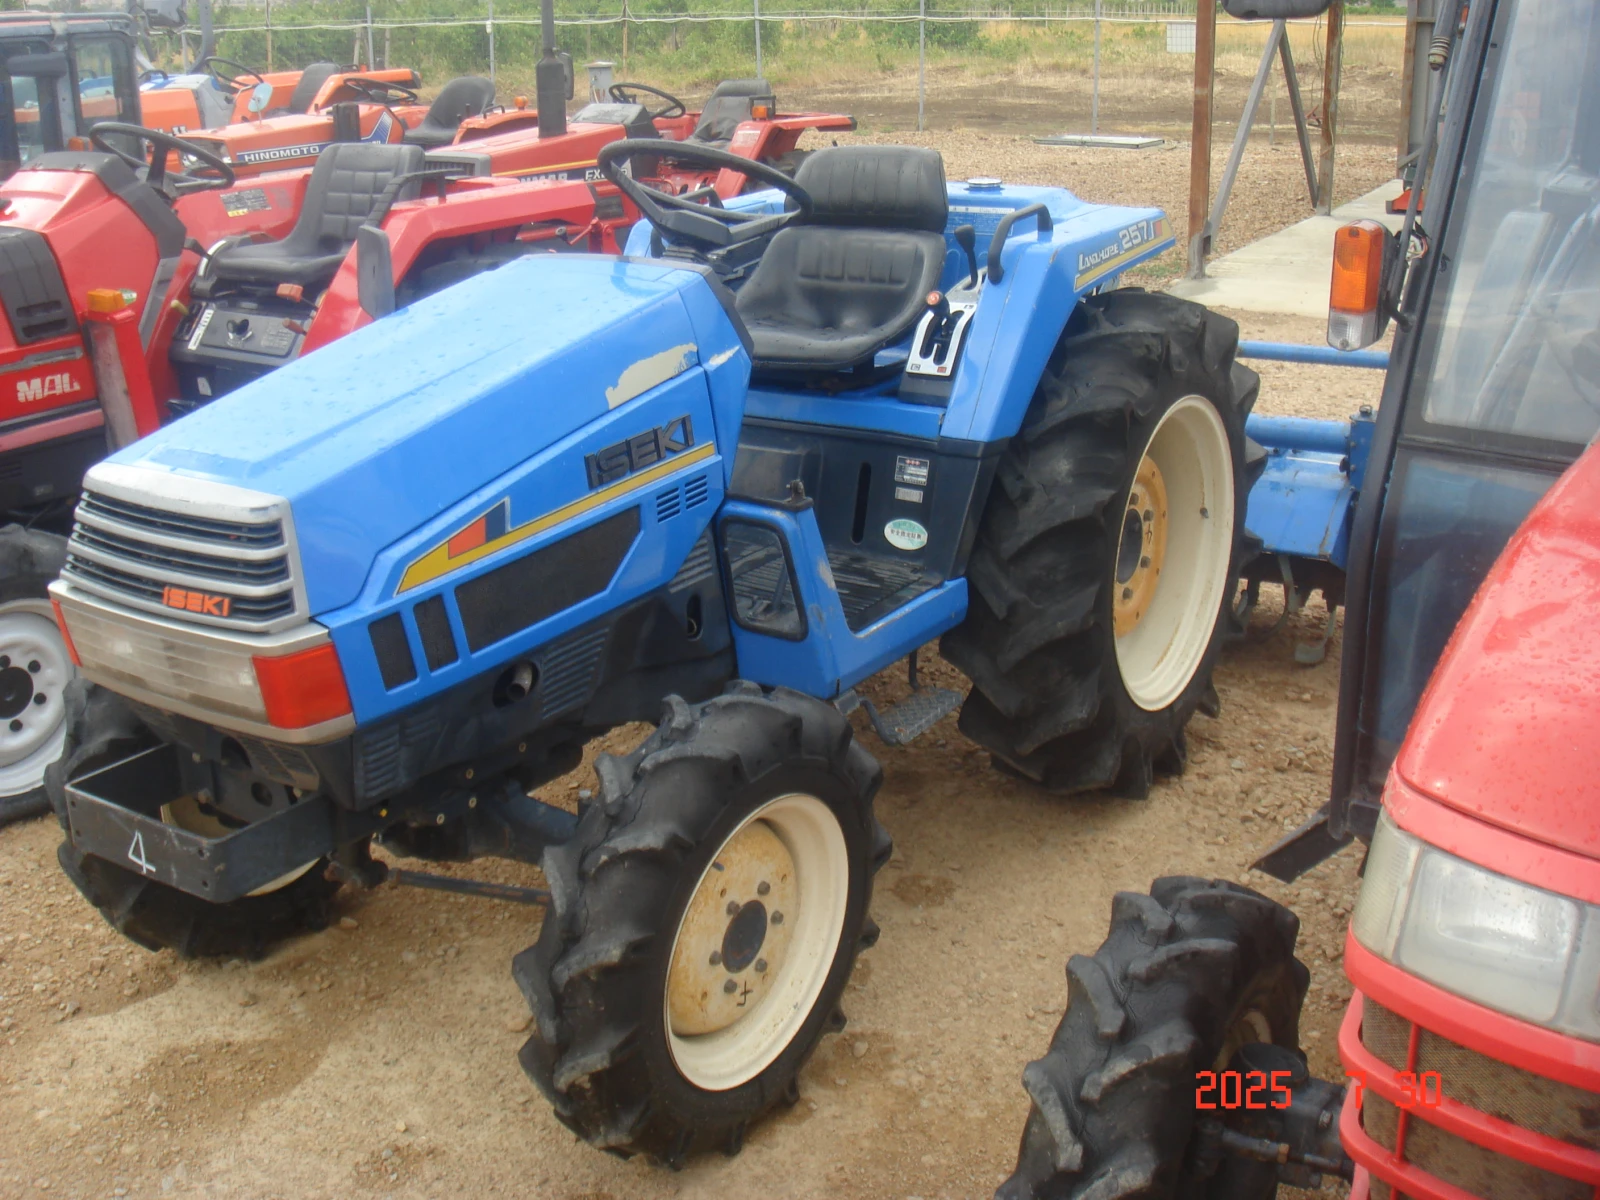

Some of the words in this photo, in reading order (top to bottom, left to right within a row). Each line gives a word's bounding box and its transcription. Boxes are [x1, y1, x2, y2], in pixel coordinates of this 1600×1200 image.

[245, 145, 320, 162] HINOMOTO
[1119, 220, 1148, 250] 257
[584, 414, 694, 490] ISEKI
[162, 586, 230, 617] ISEKI
[128, 830, 156, 874] 4
